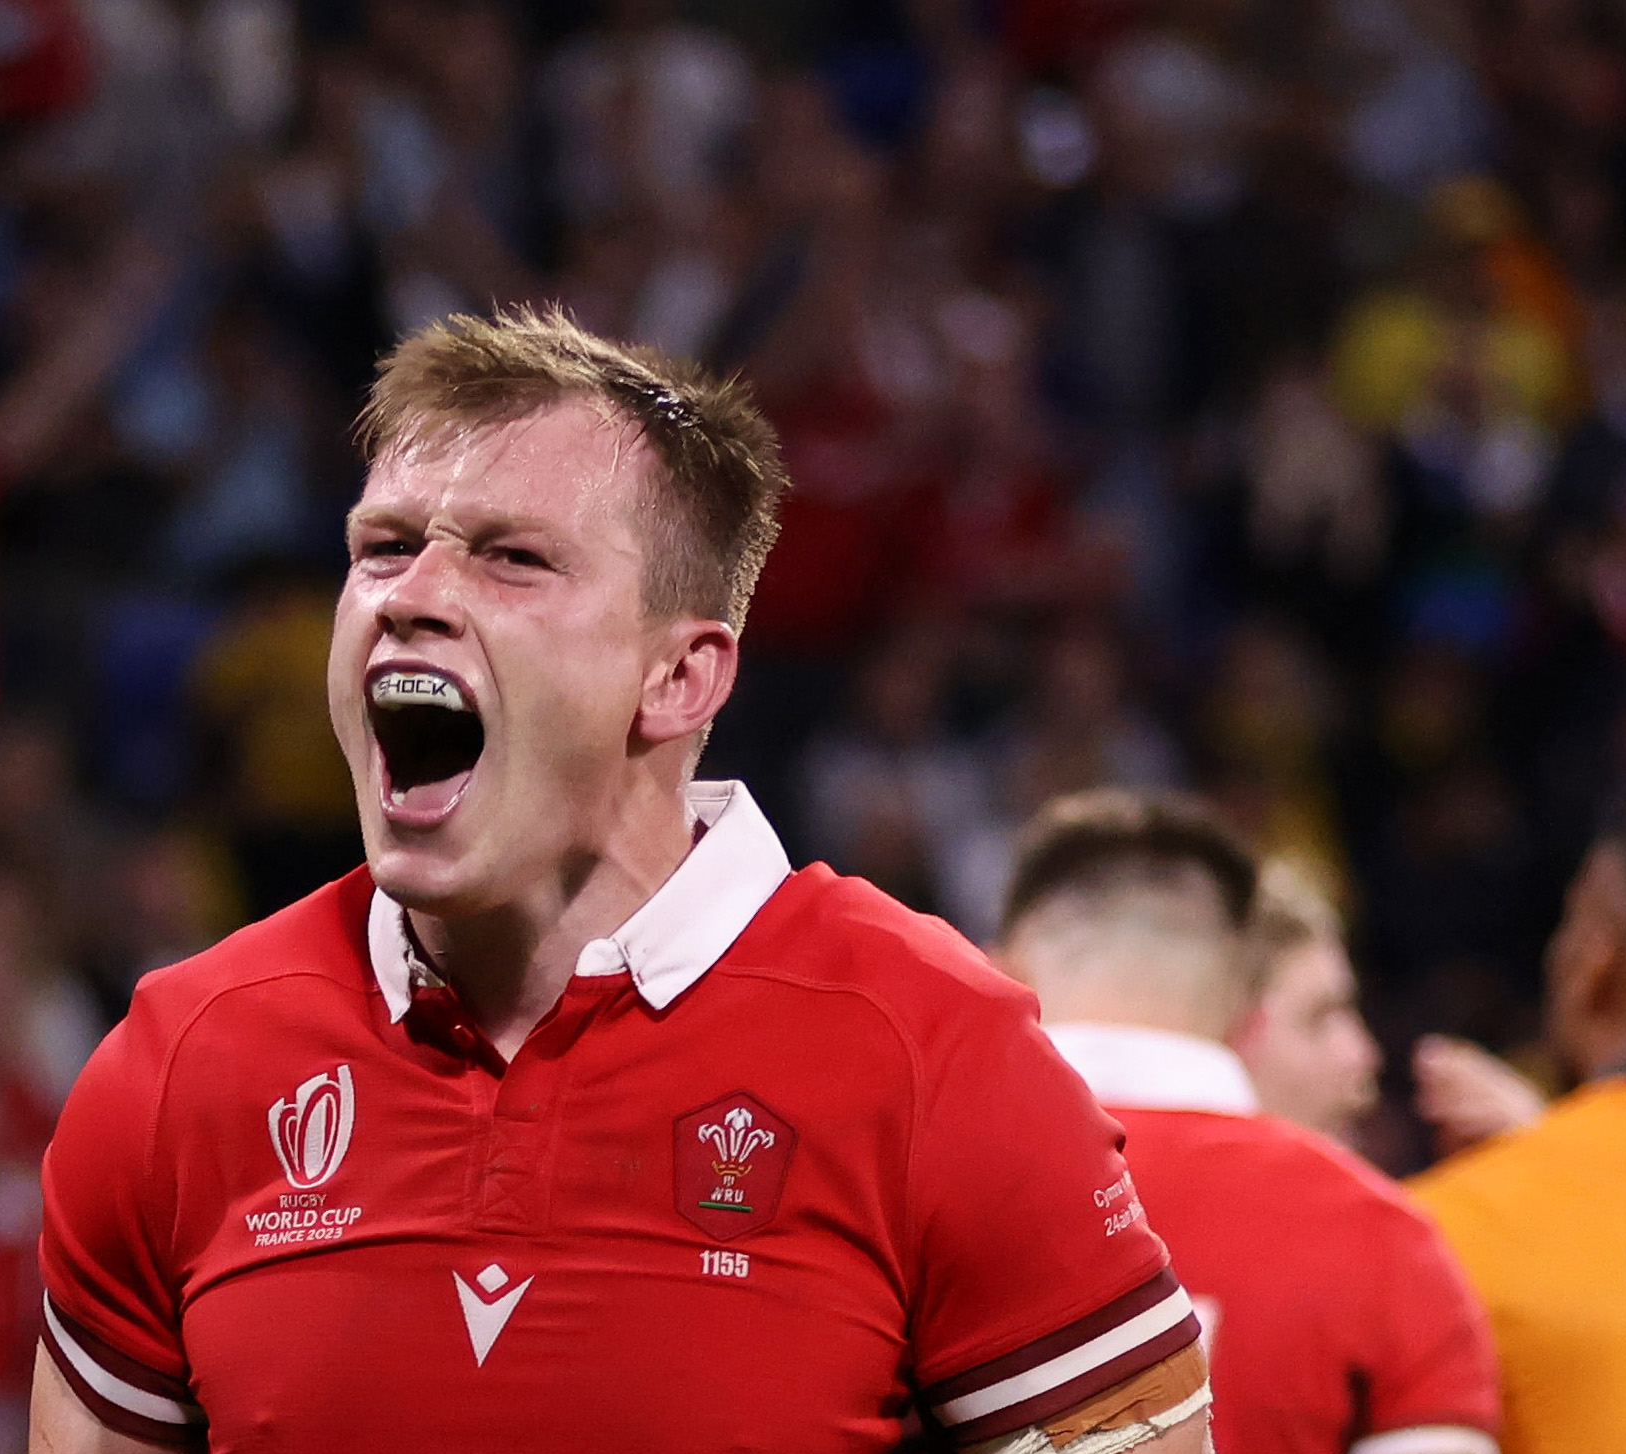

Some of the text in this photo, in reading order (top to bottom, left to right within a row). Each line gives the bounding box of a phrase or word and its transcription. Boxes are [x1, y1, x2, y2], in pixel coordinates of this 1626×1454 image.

[279, 1194, 327, 1208] RUGBY
[711, 1187, 744, 1203] WRU
[245, 1206, 362, 1232] WORLD CUP
[254, 1226, 343, 1247] FRANCE 2023
[699, 1250, 749, 1278] 1155
